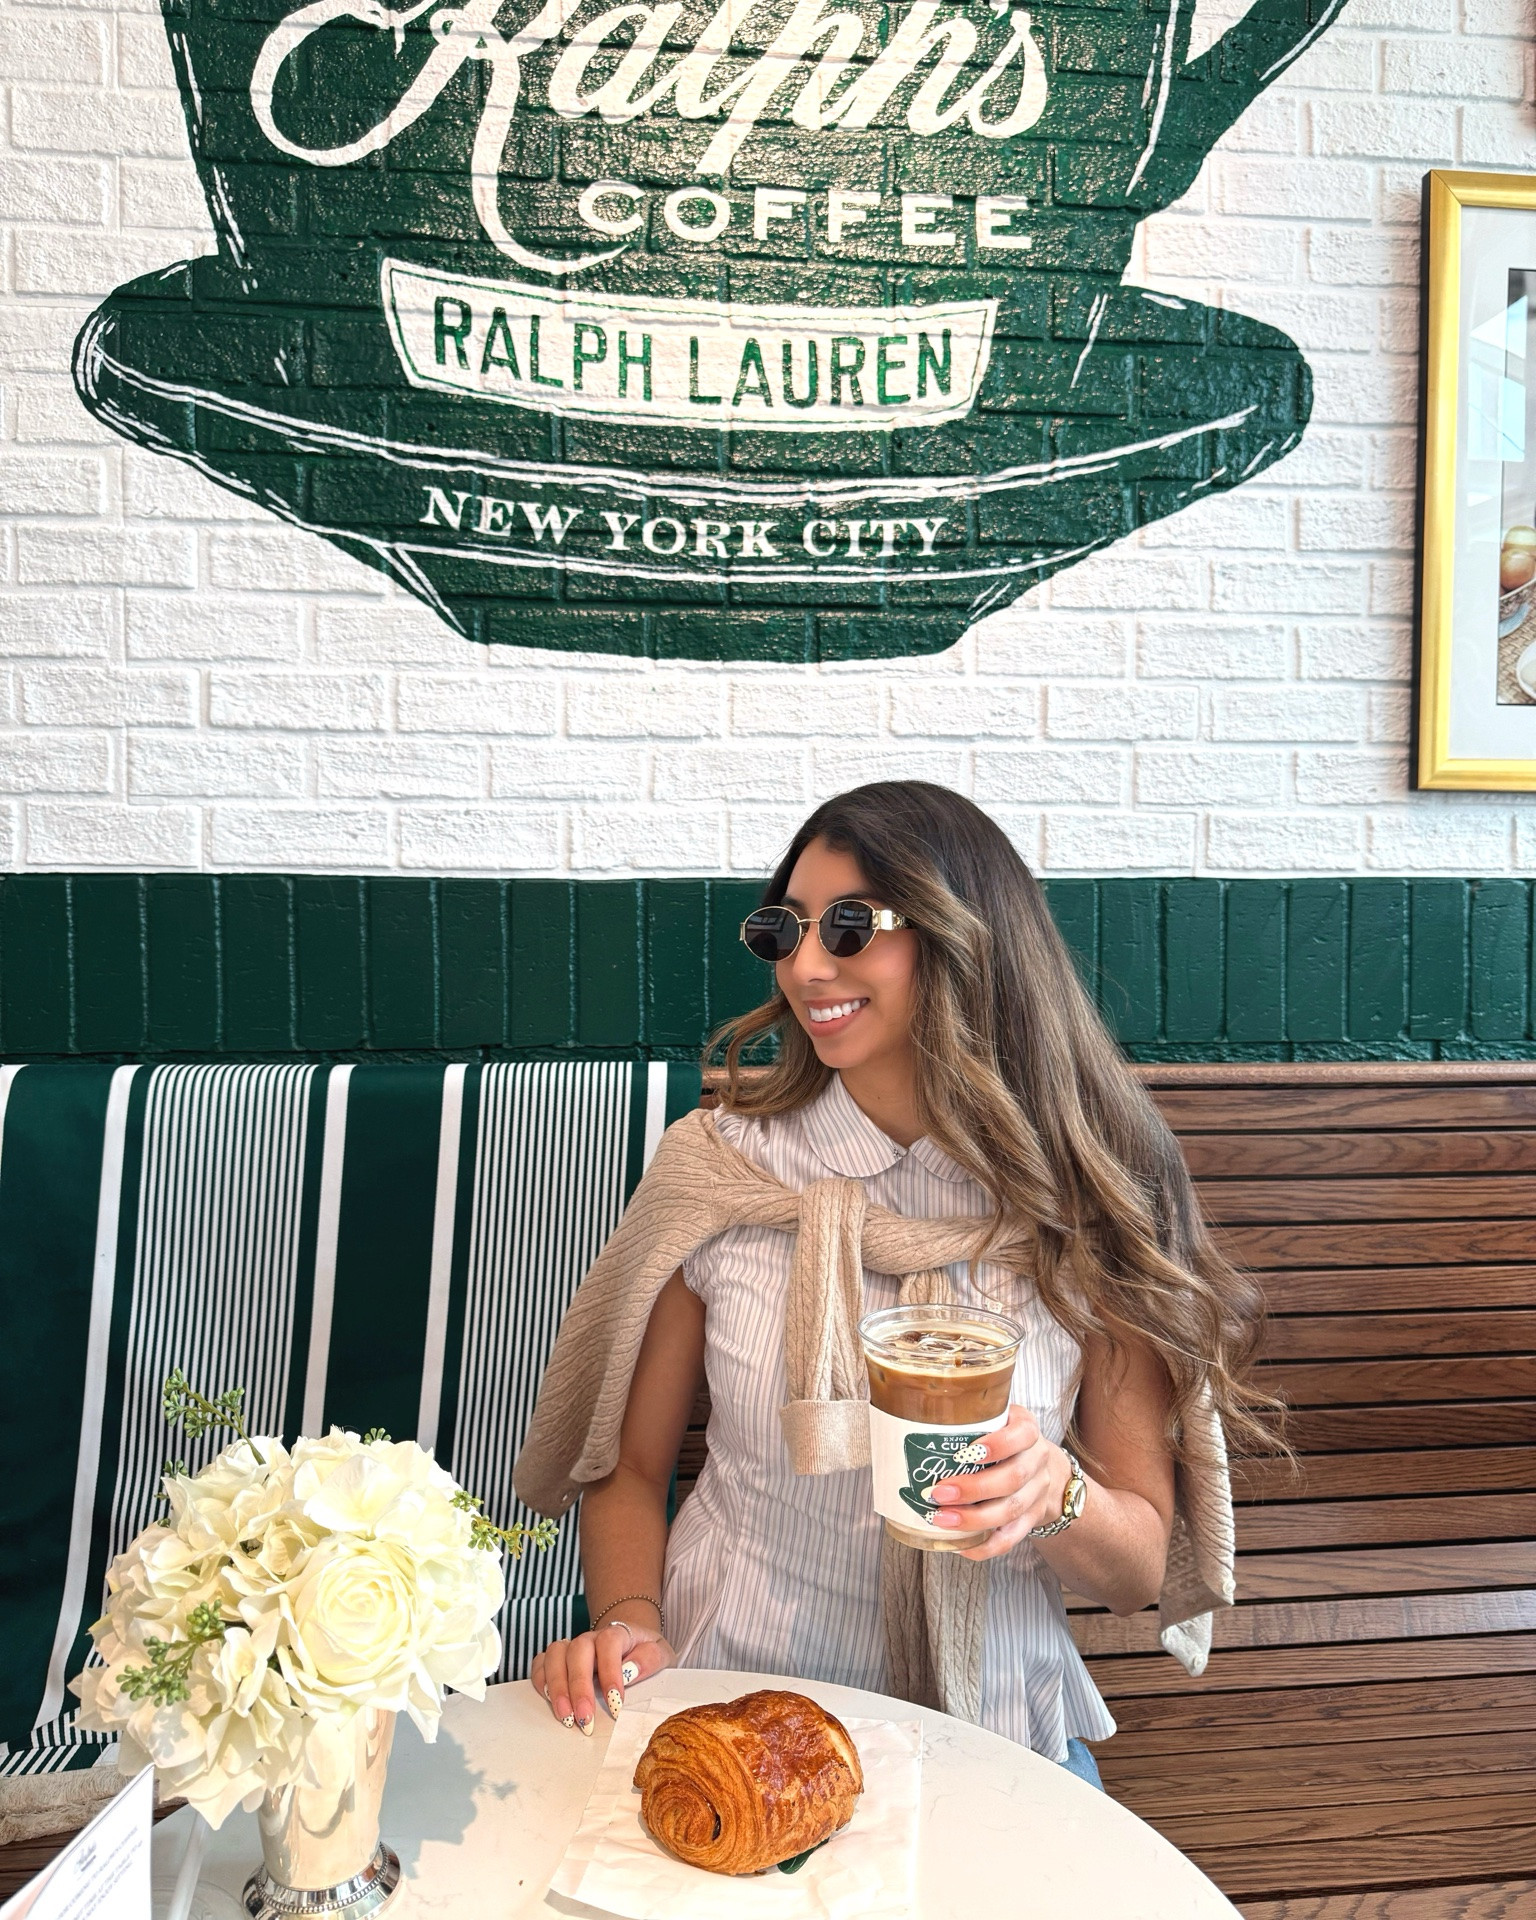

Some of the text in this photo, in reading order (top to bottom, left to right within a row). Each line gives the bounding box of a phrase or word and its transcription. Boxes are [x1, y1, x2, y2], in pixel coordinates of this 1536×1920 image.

[578, 180, 1033, 251] COFFEE
[432, 296, 954, 409] RALPH LAUREN
[420, 486, 949, 561] NEW YORK CITY
[925, 1441, 969, 1451] A CUP
